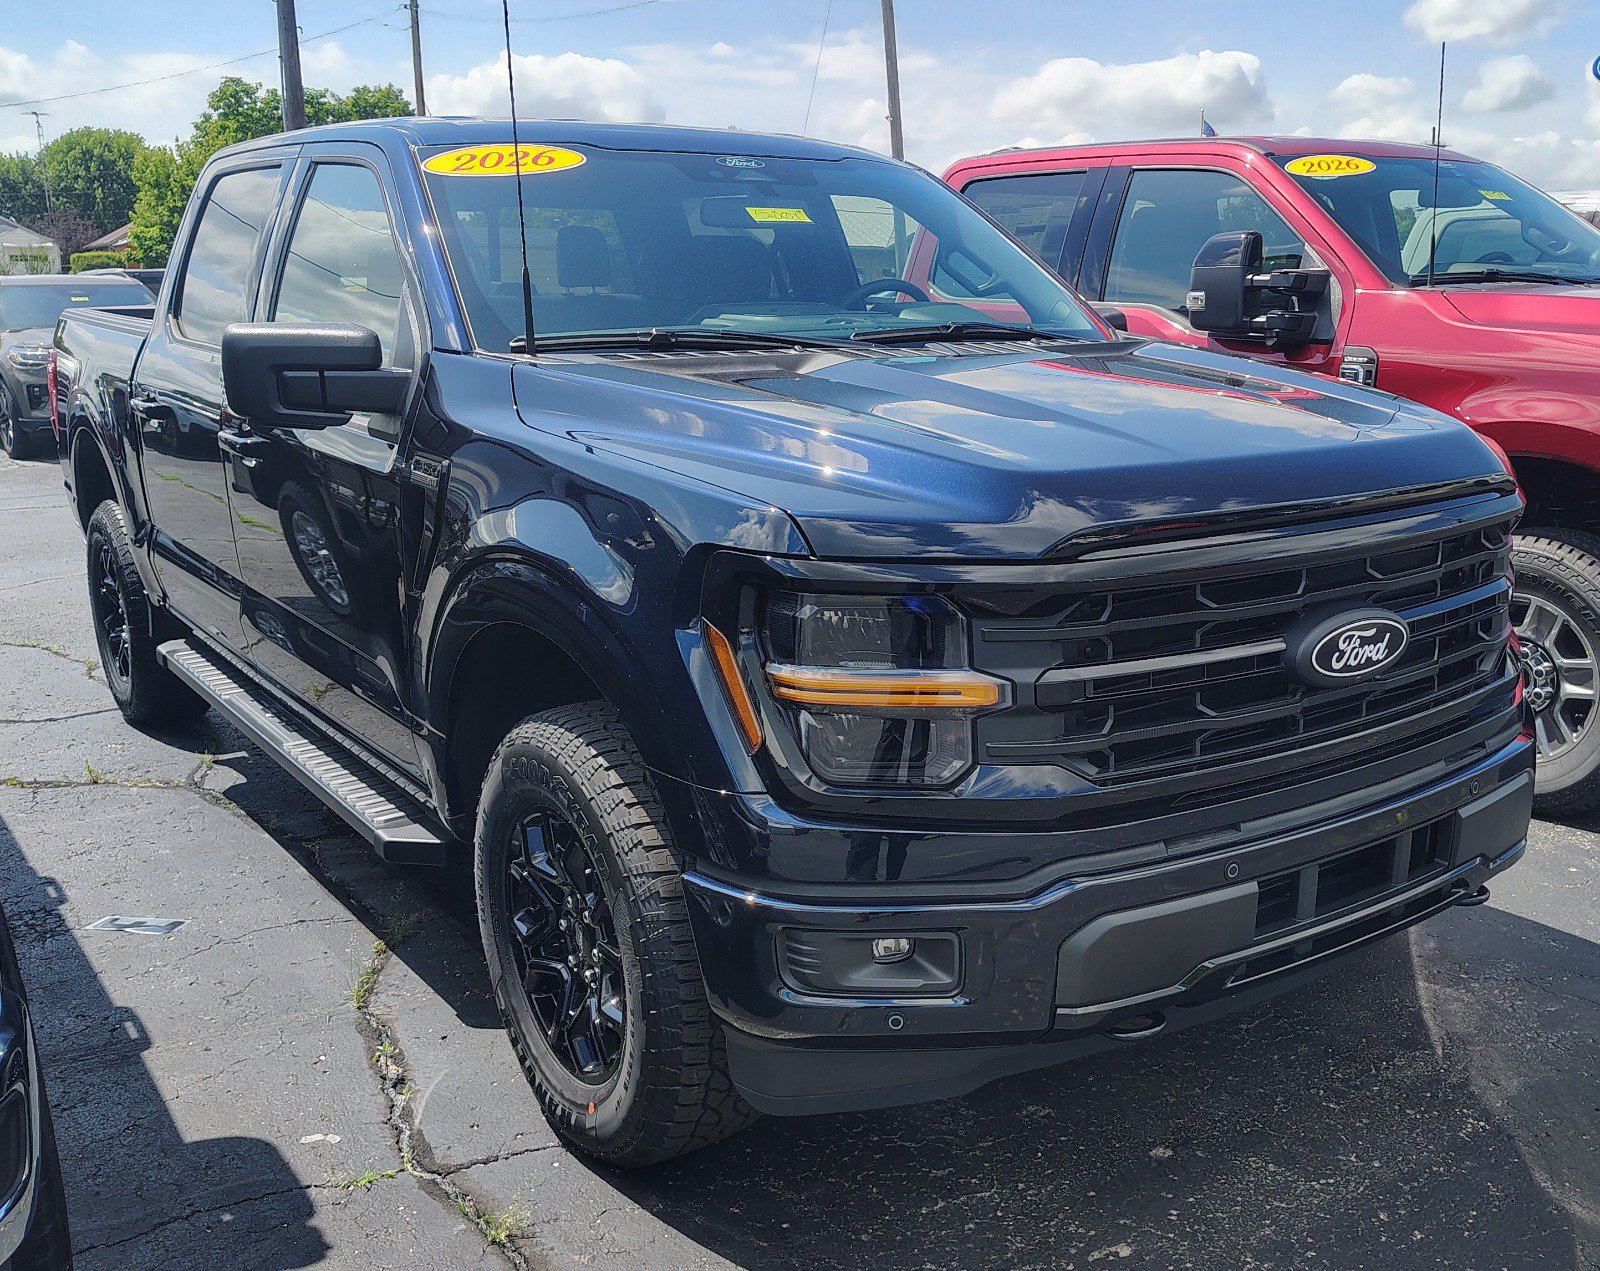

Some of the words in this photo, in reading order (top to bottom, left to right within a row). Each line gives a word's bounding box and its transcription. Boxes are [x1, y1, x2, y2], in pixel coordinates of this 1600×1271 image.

[451, 149, 557, 172] 2026
[725, 158, 758, 167] Ford
[1302, 159, 1360, 174] 2026
[1331, 627, 1391, 670] Ford
